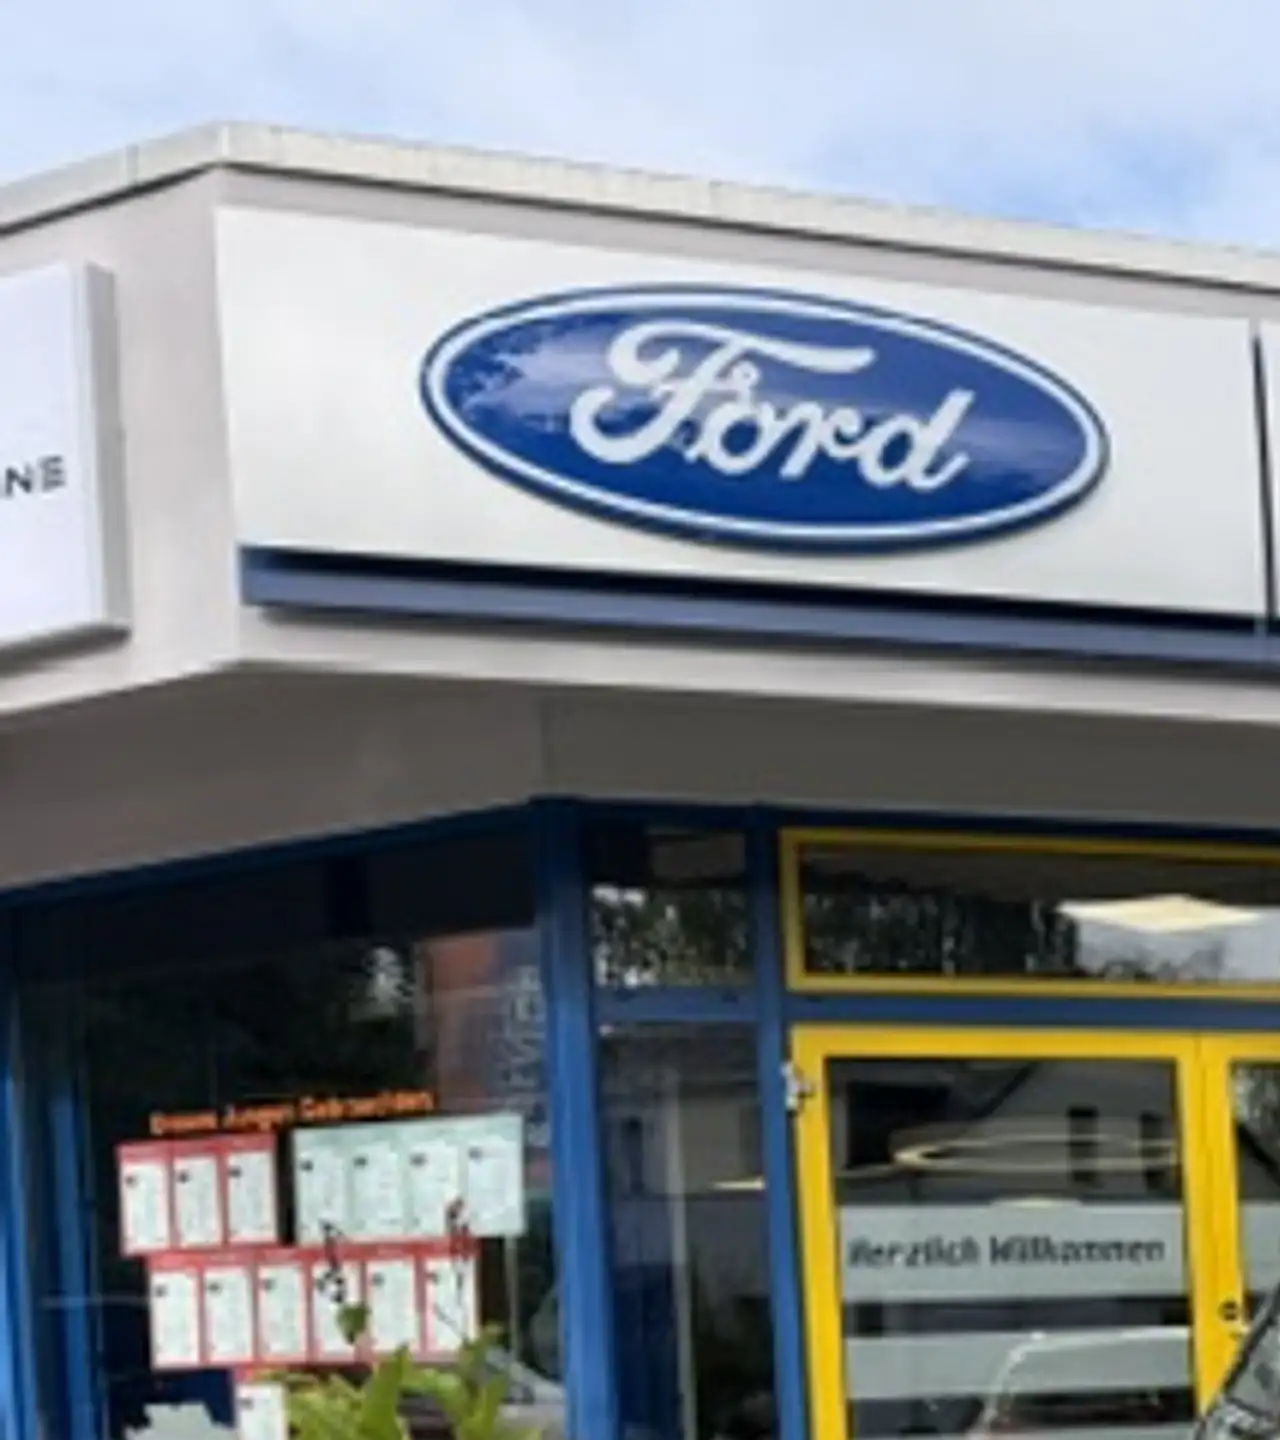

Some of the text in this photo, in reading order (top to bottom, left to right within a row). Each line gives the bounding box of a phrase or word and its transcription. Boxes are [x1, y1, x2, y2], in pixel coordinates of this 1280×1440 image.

[569, 320, 975, 491] Ford
[0, 455, 67, 498] NE
[989, 1234, 1166, 1266] Willkommen
